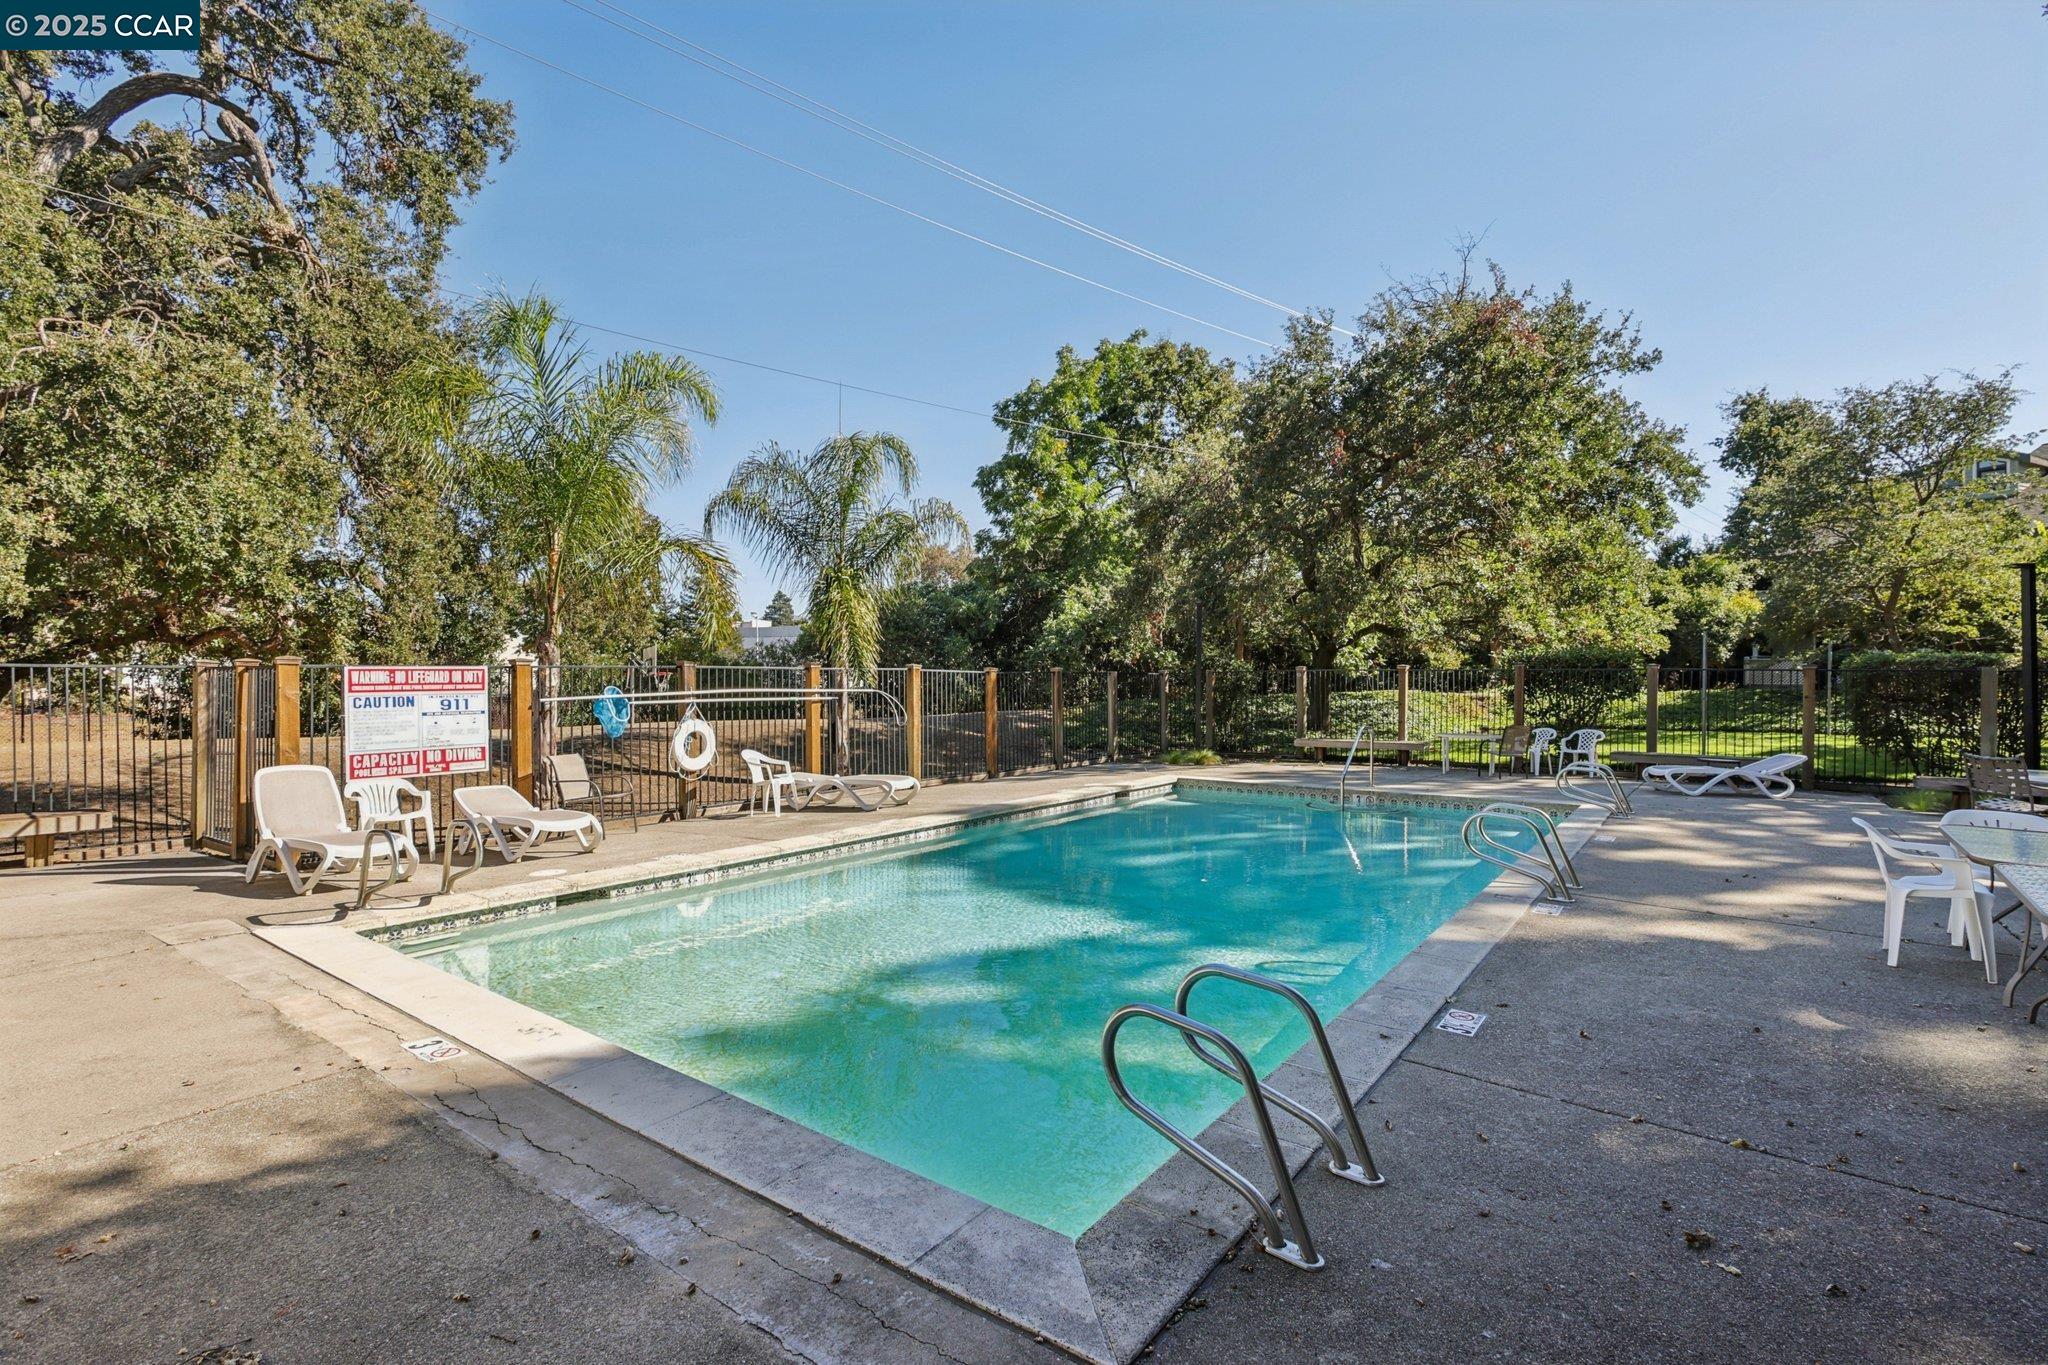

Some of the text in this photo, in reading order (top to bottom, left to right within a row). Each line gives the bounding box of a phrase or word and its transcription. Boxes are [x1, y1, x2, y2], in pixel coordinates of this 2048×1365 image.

[351, 670, 484, 684] WARNING: NO LIFEGUARD ON DUTY
[353, 696, 415, 709] CAUTION
[440, 698, 469, 711] 911
[352, 751, 419, 769] CAPACITY
[427, 748, 482, 763] NO DIVING
[354, 768, 371, 778] POOL
[388, 766, 402, 775] SPA
